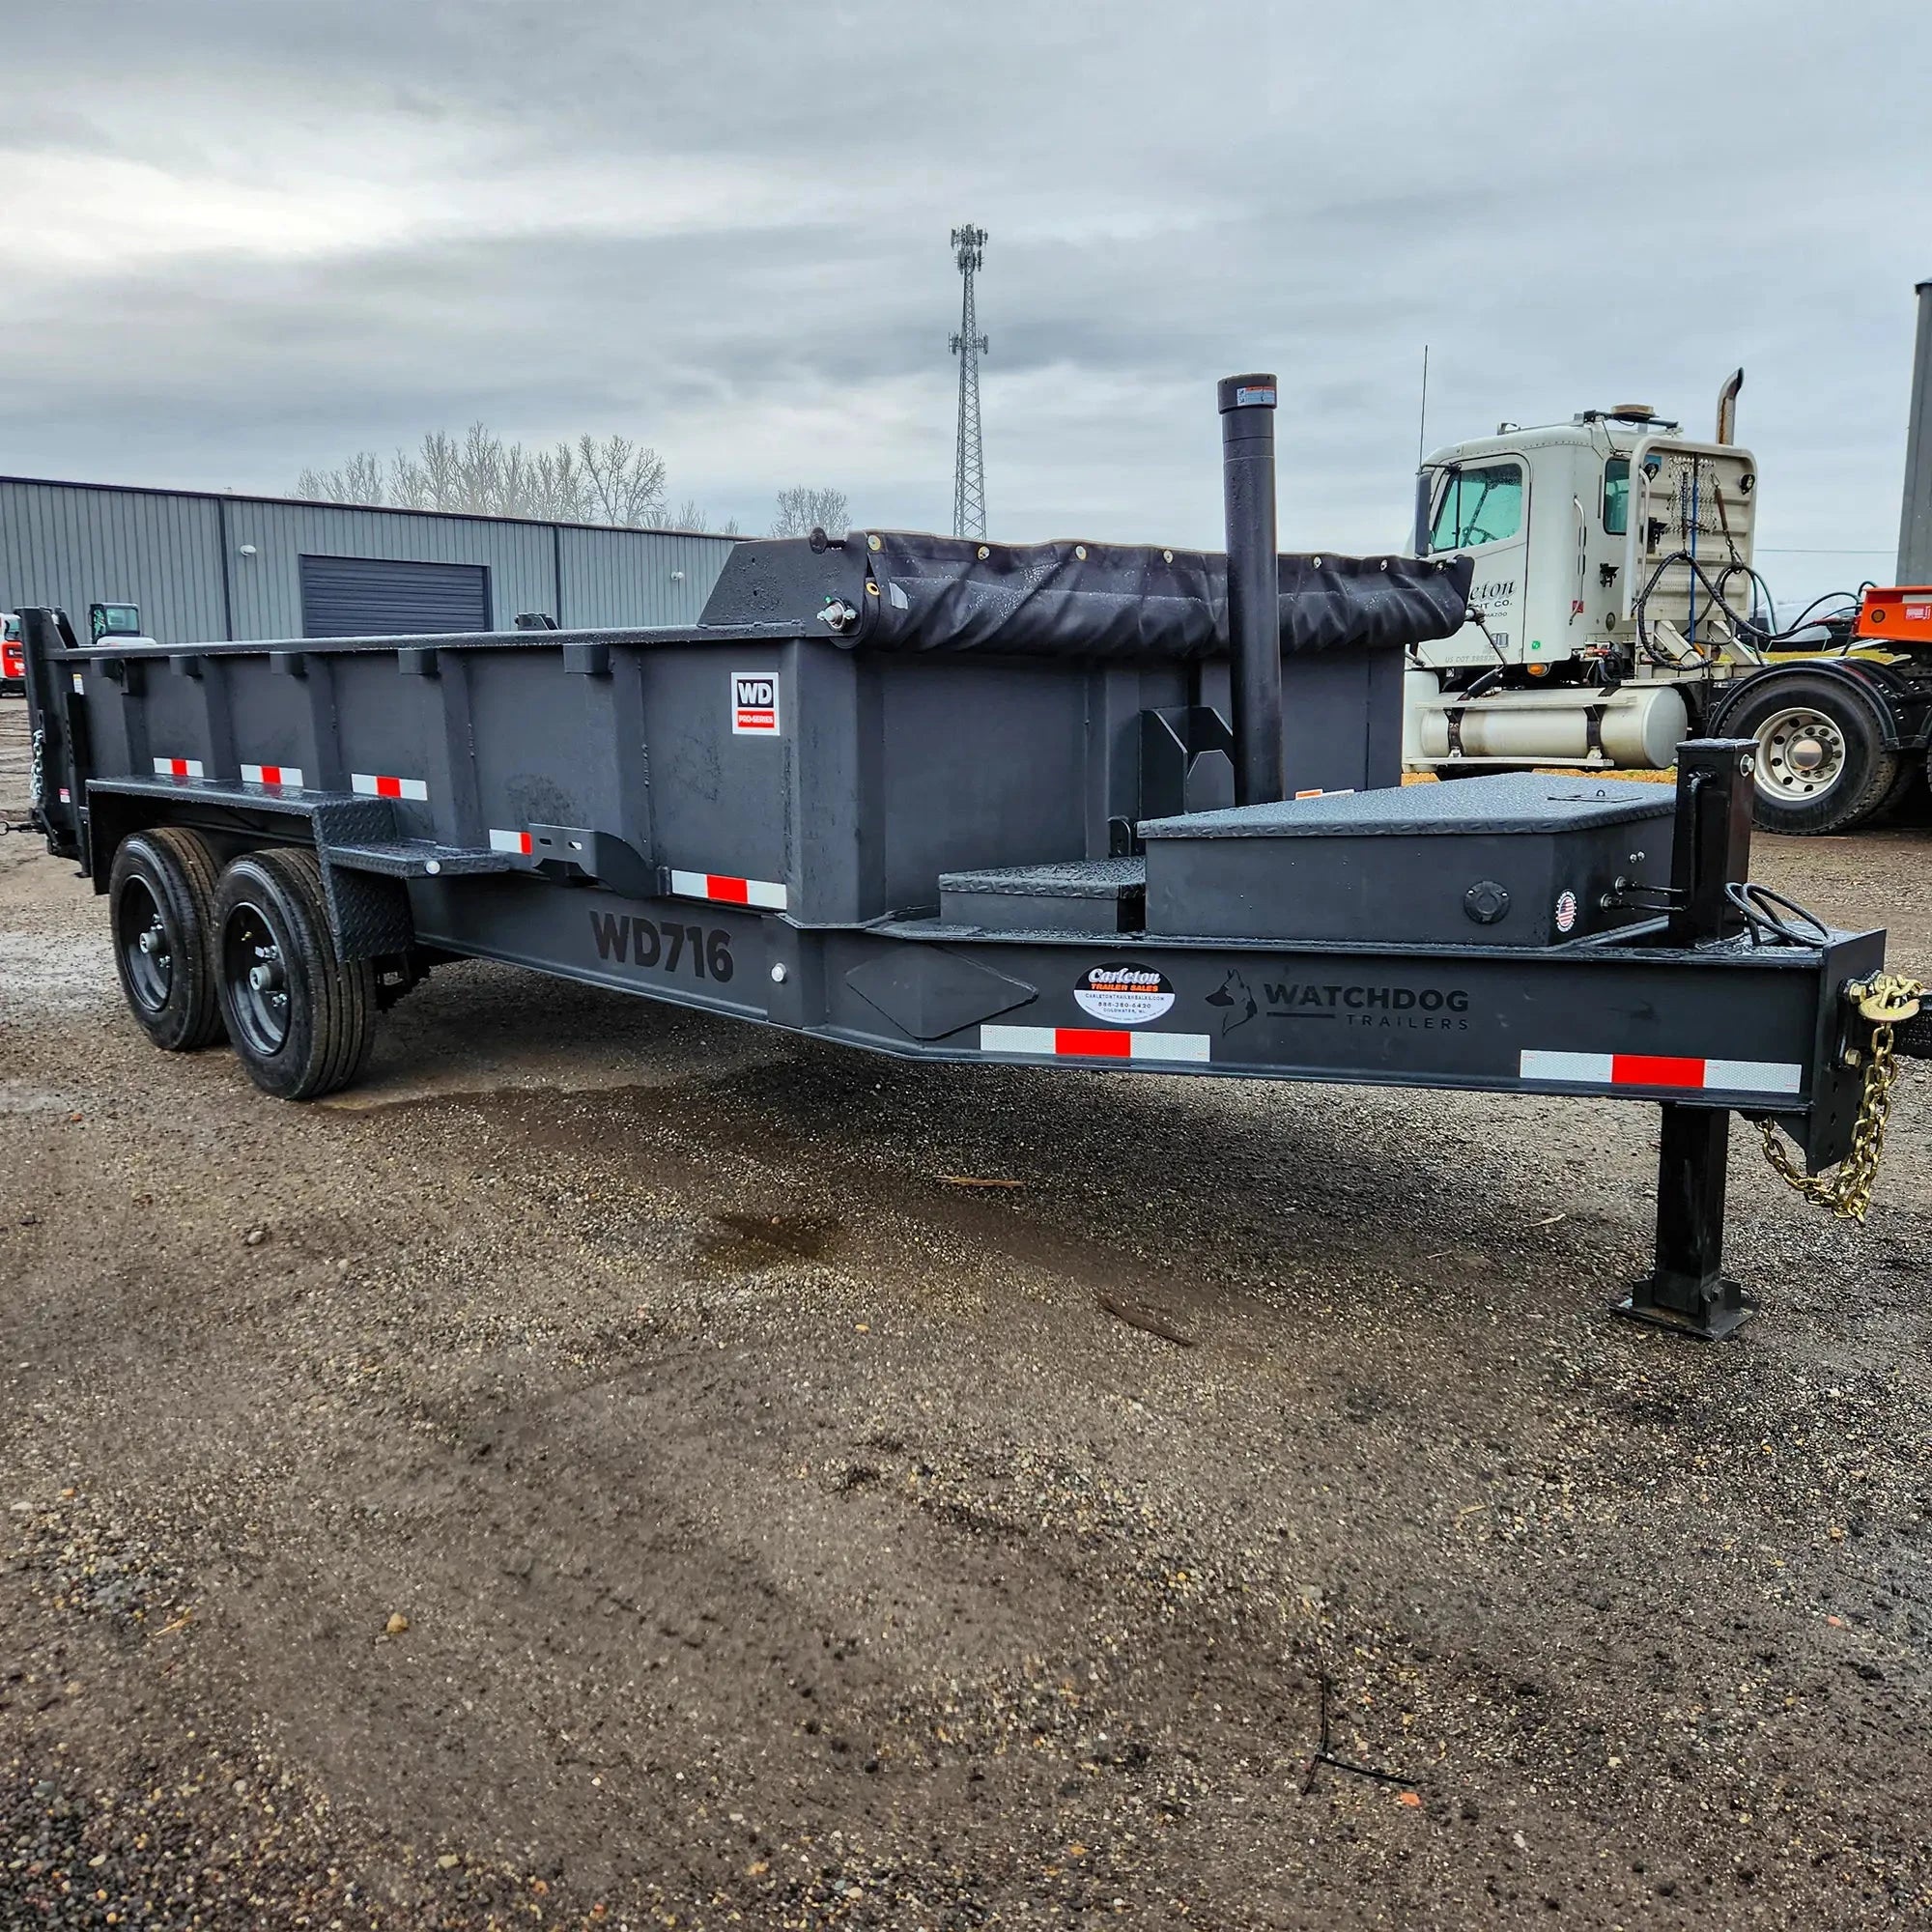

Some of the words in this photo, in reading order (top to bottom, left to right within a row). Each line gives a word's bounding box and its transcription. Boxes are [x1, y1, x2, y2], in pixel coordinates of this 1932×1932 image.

[737, 682, 773, 704] WD
[589, 911, 734, 983] WD716
[1088, 968, 1161, 985] Carleton
[1264, 983, 1469, 1012] WATCHDOG
[1347, 1014, 1468, 1031] TRAILERS
